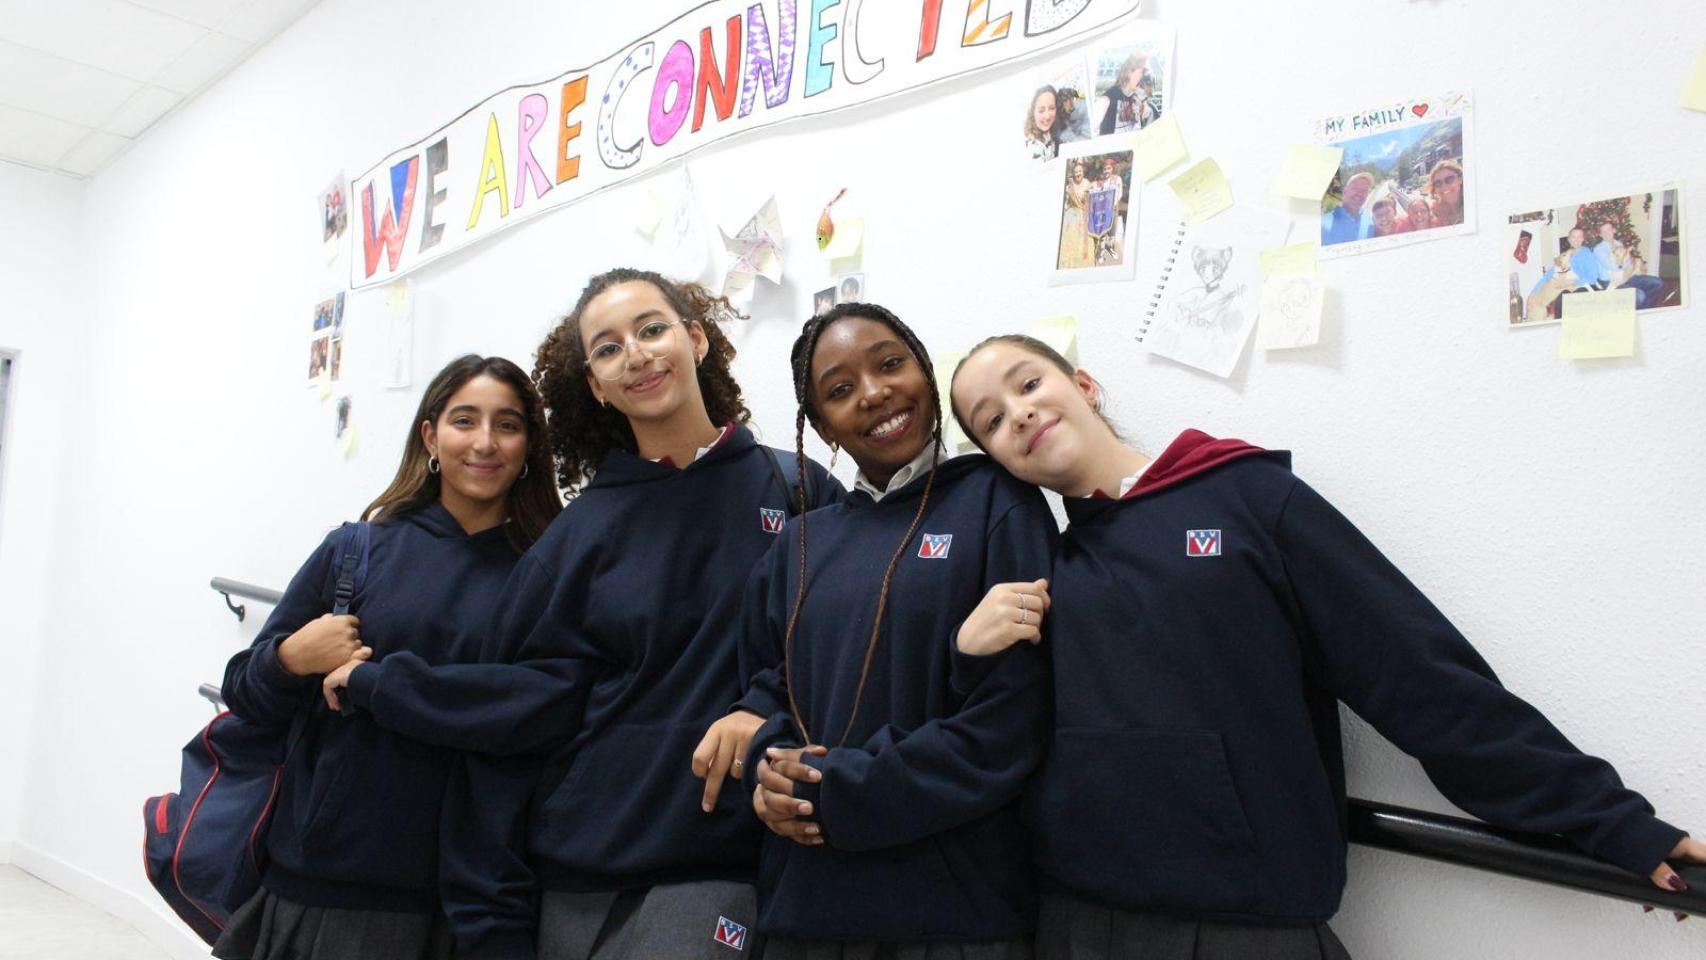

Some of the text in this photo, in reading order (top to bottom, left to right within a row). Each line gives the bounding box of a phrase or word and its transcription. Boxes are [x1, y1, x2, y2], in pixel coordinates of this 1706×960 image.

[362, 137, 449, 279] WE
[466, 75, 589, 231] ARE
[1326, 106, 1405, 135] MY FAMILY
